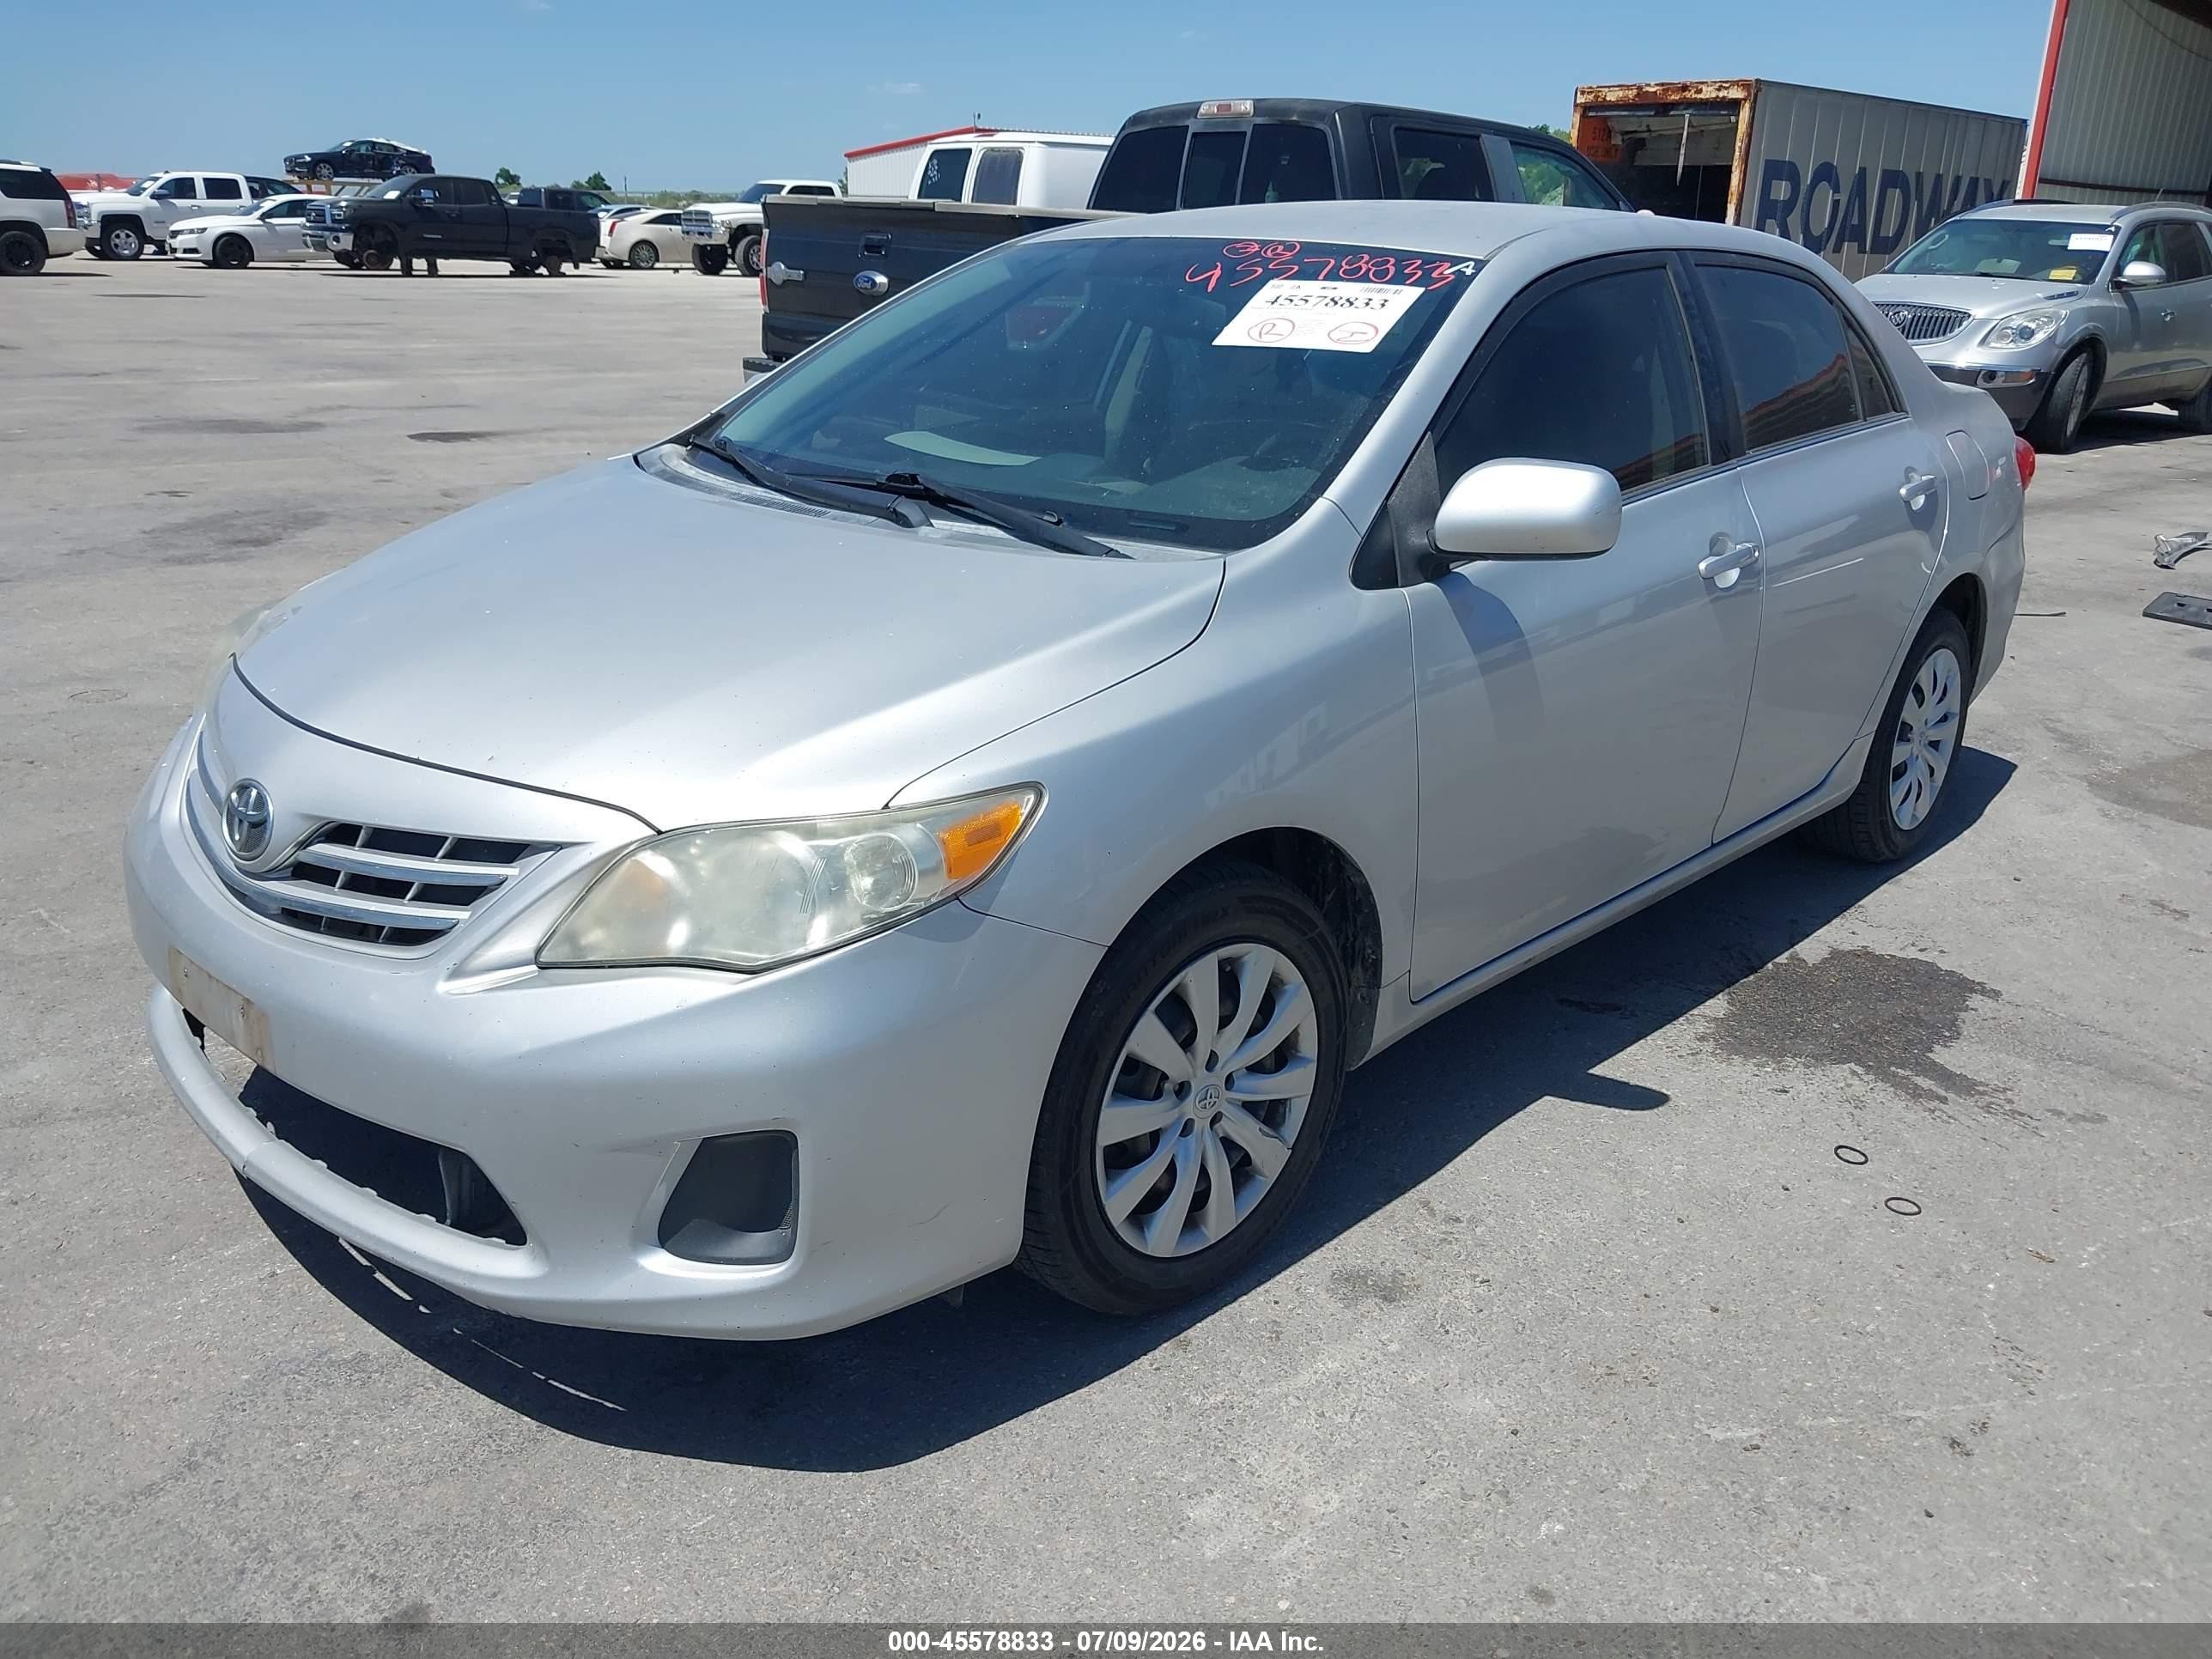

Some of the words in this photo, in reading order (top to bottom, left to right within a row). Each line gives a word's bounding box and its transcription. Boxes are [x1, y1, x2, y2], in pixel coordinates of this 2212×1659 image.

[1756, 159, 2010, 254] ROADWAY
[1185, 254, 1455, 292] 45578833
[1265, 295, 1389, 310] 45578833
